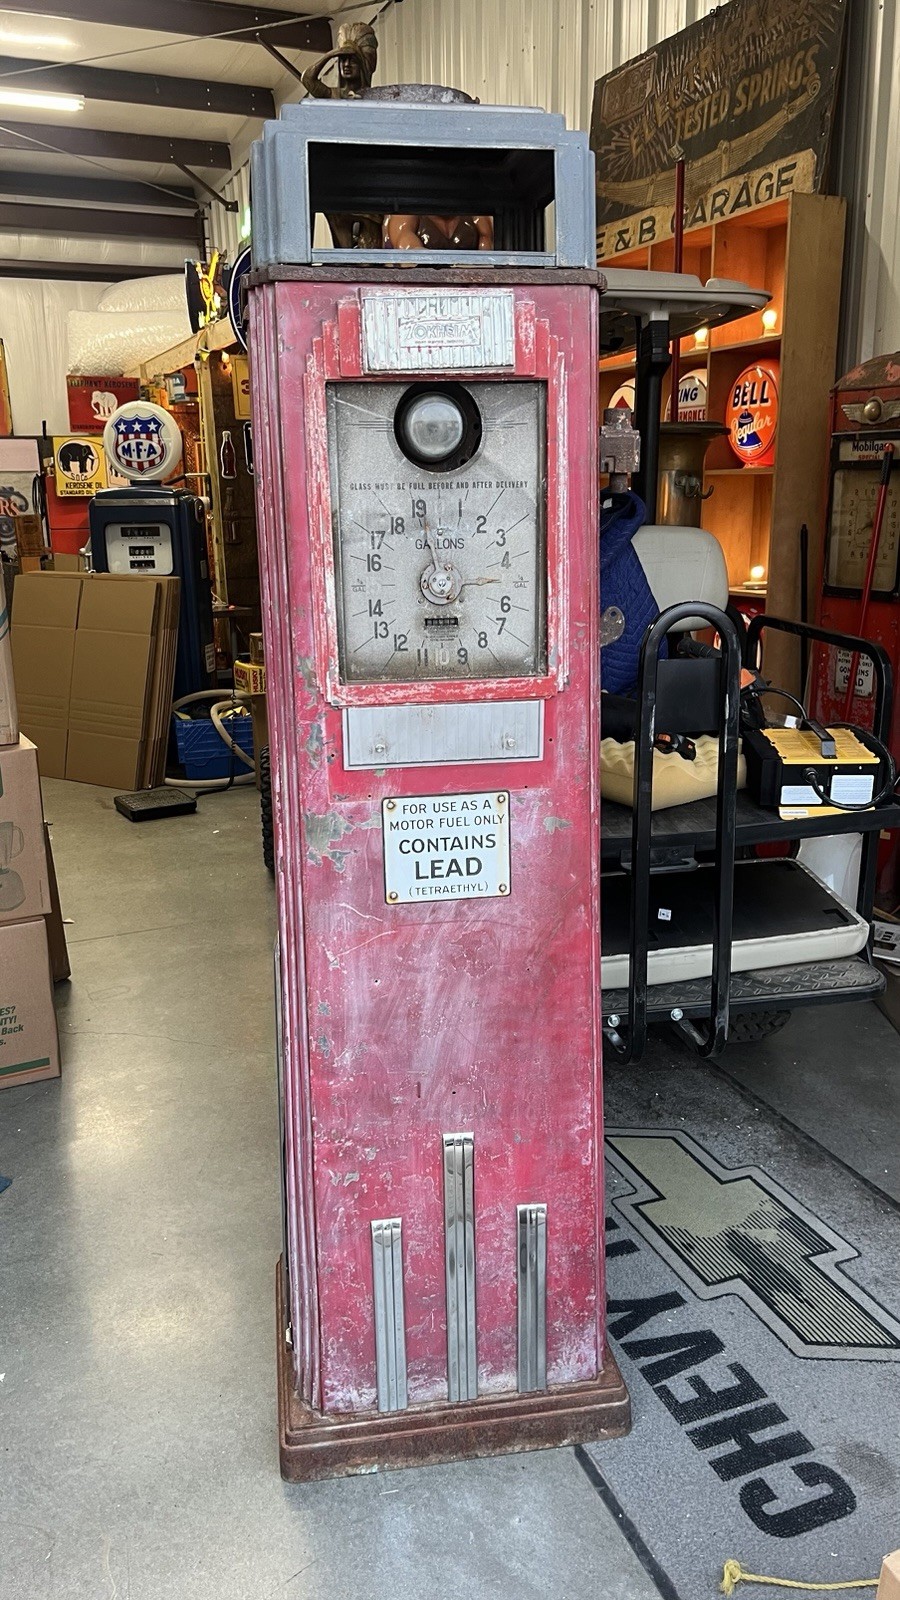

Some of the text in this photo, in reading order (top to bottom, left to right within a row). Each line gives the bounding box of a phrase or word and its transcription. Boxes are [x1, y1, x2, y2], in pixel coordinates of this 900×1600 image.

[674, 85, 731, 144] TESTED
[733, 44, 820, 117] SPRINGS
[614, 227, 632, 252] &
[639, 215, 656, 245] B
[670, 161, 797, 234] GARAGE
[678, 387, 699, 402] ING
[733, 381, 769, 408] BELL
[731, 411, 772, 445] Regular
[852, 440, 884, 454] Mobilga
[428, 482, 453, 490] BEFORE
[496, 480, 528, 488] DELIVERY
[411, 499, 427, 518] 19
[458, 498, 462, 518] 1
[390, 517, 405, 535] 18
[476, 515, 487, 534] 2
[370, 531, 386, 550] 17
[415, 538, 464, 550] GALONS
[496, 529, 507, 547] 3
[366, 554, 382, 572] 16
[500, 551, 511, 569] 4
[369, 599, 383, 617] 14
[501, 596, 511, 613] 6
[374, 621, 389, 639] 13
[495, 617, 507, 635] 7
[393, 634, 408, 651] 12
[477, 632, 488, 648] 8
[457, 648, 468, 665] 9
[402, 800, 491, 814] FOR USE AS A
[390, 814, 504, 831] MOTOR FUEL ONLY
[399, 834, 496, 854] CONTAINS
[415, 857, 482, 880] LEAD
[409, 881, 488, 897] (TETRAETHYL)
[2, 1024, 24, 1035] Back
